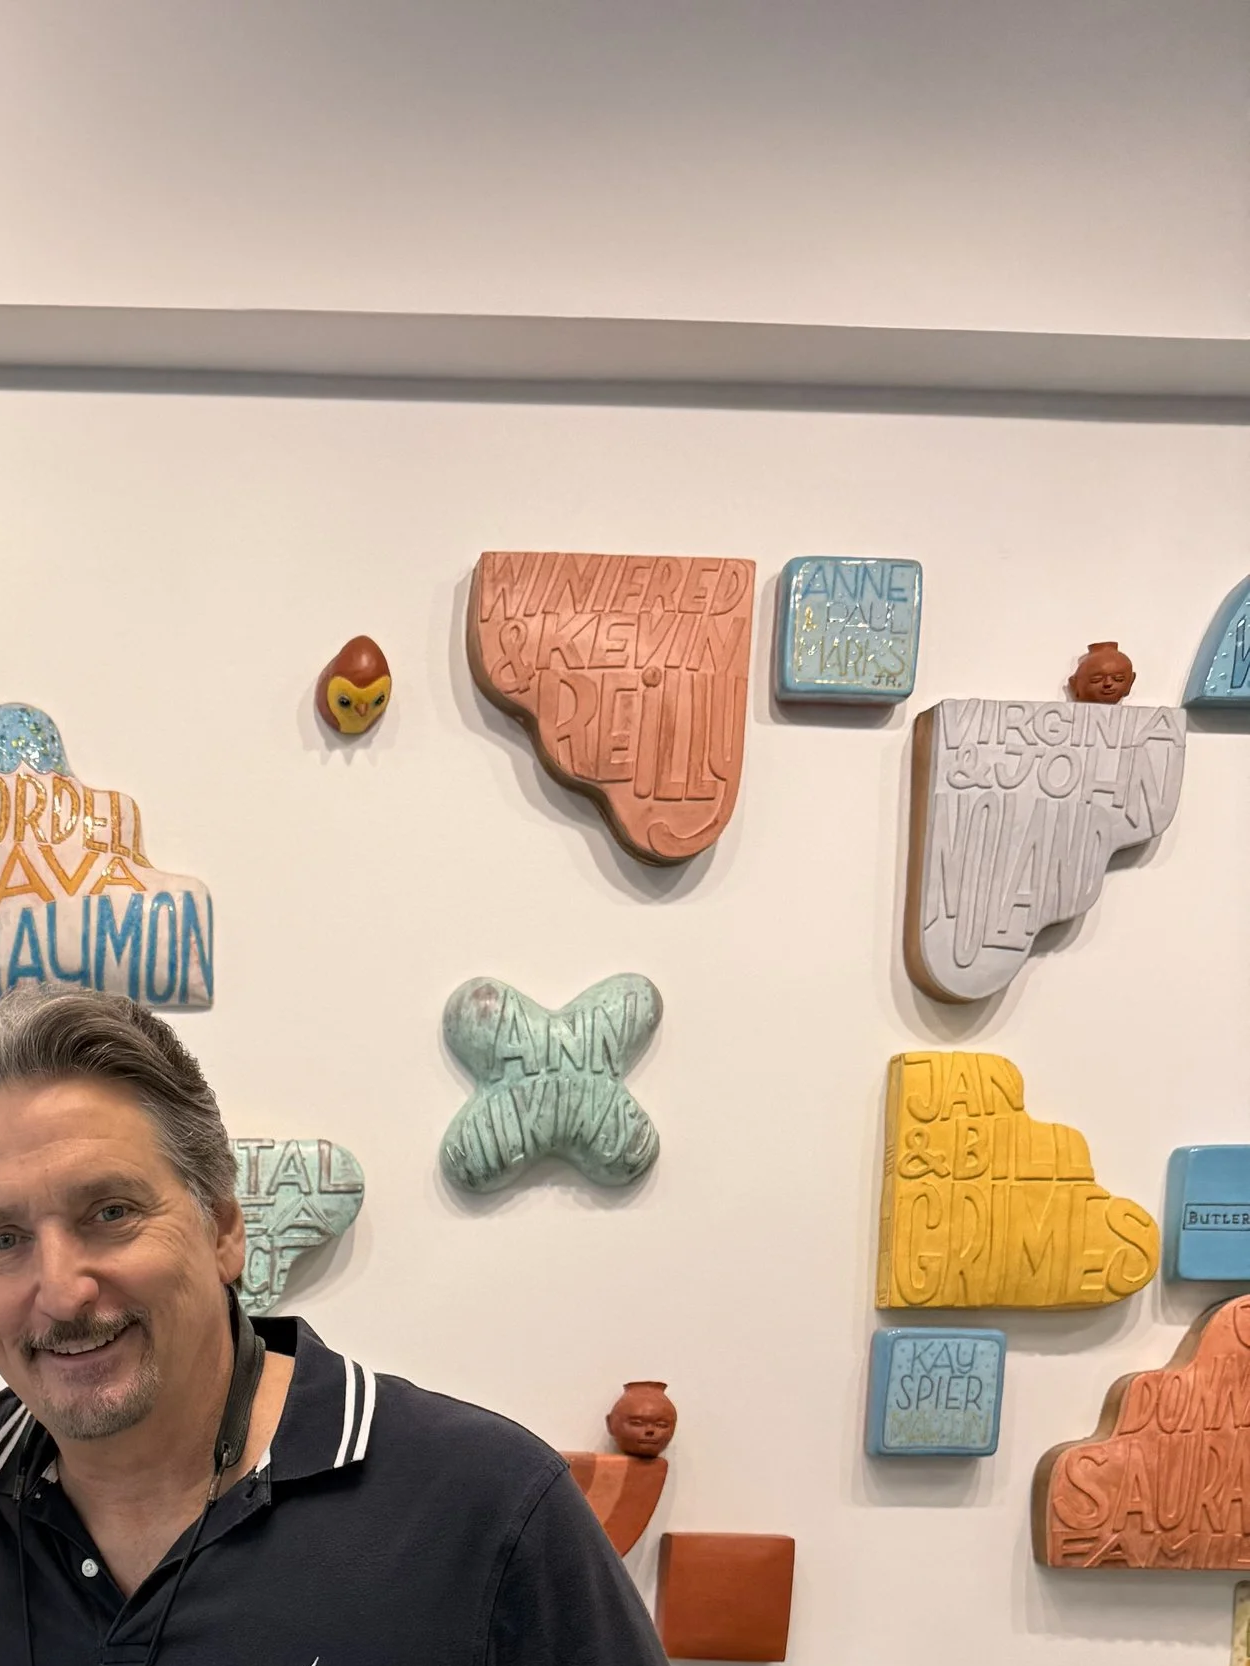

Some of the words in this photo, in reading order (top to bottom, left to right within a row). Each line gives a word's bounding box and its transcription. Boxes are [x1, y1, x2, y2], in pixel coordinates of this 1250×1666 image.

[480, 552, 750, 622] WINIFRED
[801, 563, 913, 602] ANNE
[825, 601, 908, 634] PAUL
[491, 619, 534, 694] &
[536, 612, 746, 671] KEVIN
[797, 636, 905, 677] MARKS
[872, 674, 901, 688] JR.
[940, 699, 1186, 749] VIRGINIA
[947, 744, 992, 789] &
[995, 747, 1185, 837] JOHN
[924, 792, 1112, 968] NOLAND
[490, 988, 637, 1083] ANN
[903, 1051, 1024, 1122] JAN
[232, 1138, 364, 1195] TAL
[900, 1127, 950, 1180] &
[952, 1117, 1094, 1181] BILL
[895, 1181, 1159, 1306] GRIMES
[911, 1341, 977, 1374] KAY
[896, 1375, 982, 1411] SPIER
